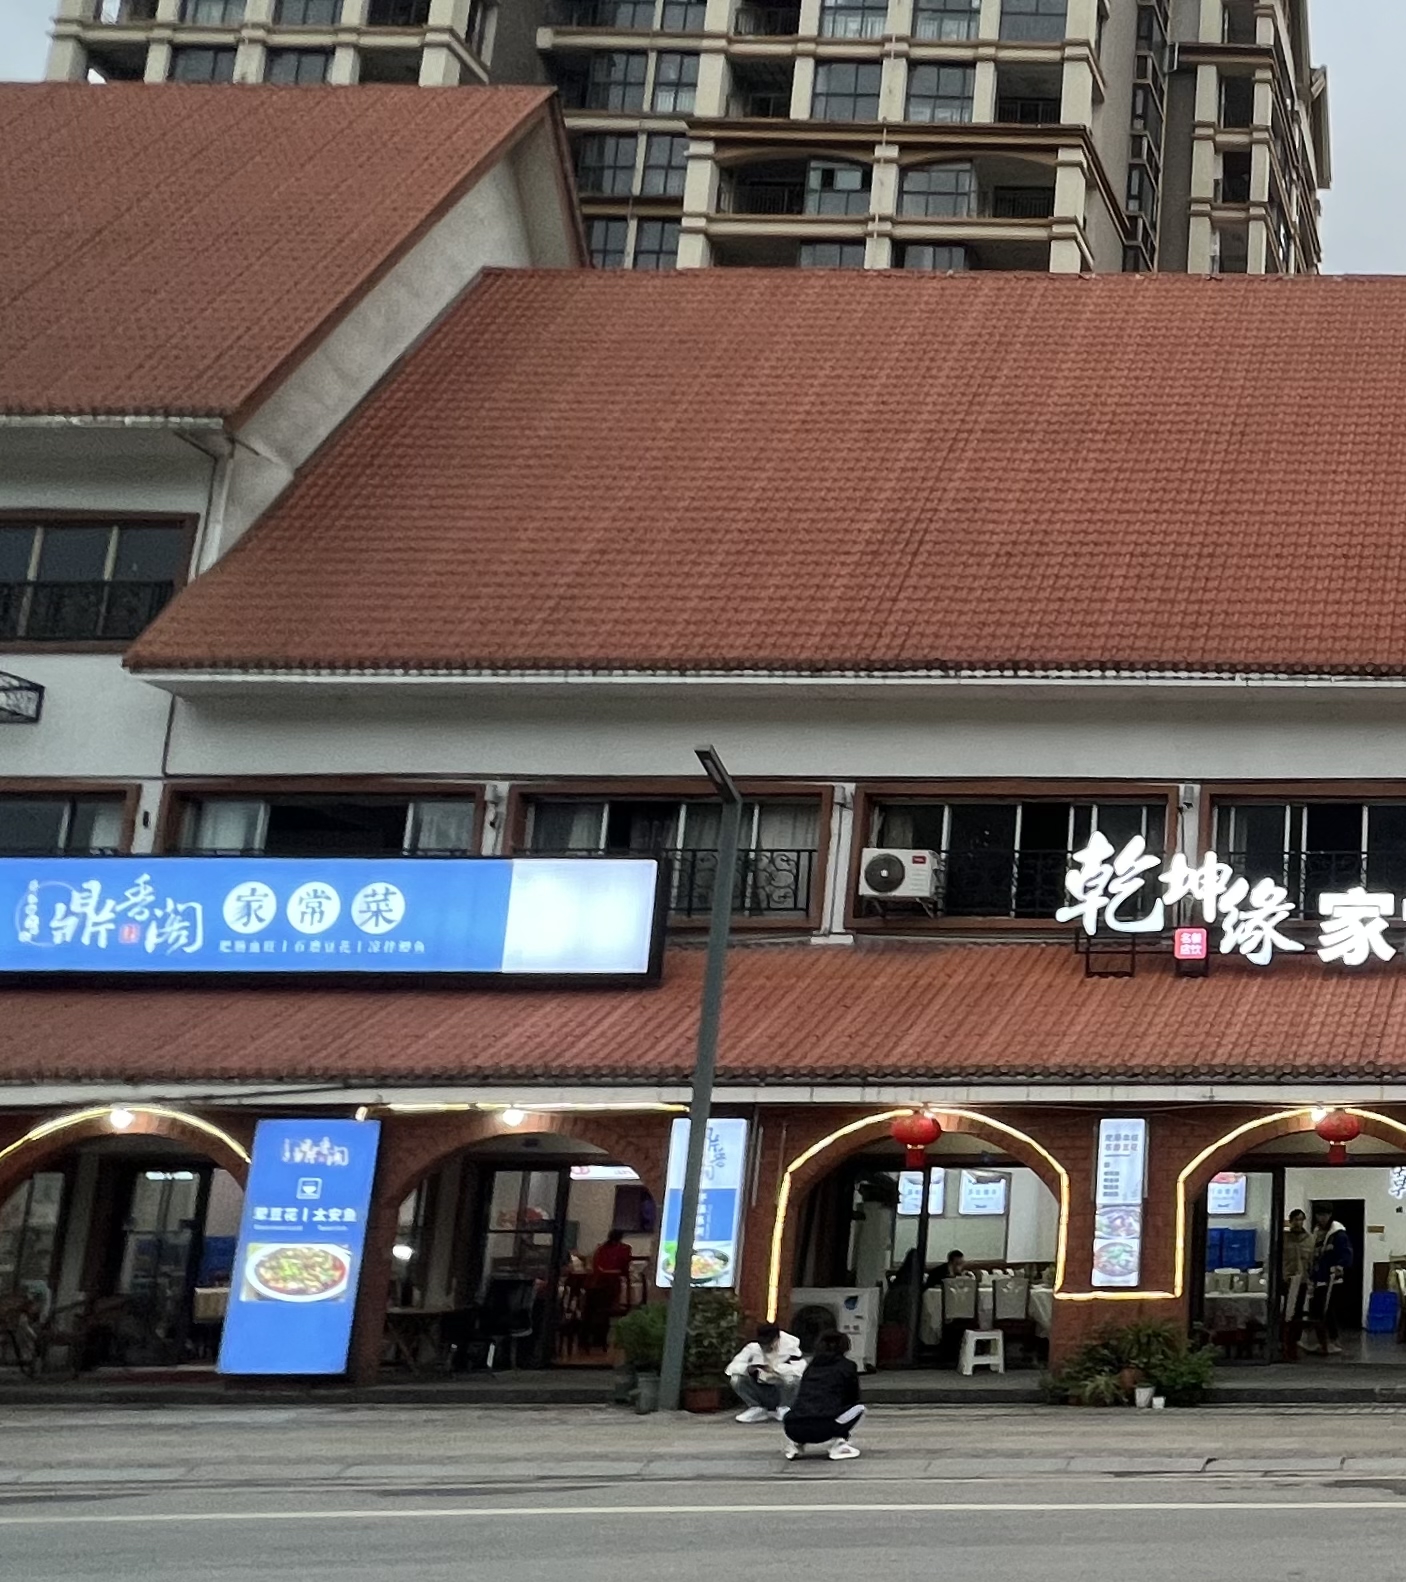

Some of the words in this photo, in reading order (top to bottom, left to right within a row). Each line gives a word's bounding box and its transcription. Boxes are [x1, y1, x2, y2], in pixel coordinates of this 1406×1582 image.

[229, 886, 400, 929] 家常菜
[1055, 830, 1306, 965] 乾坤缘
